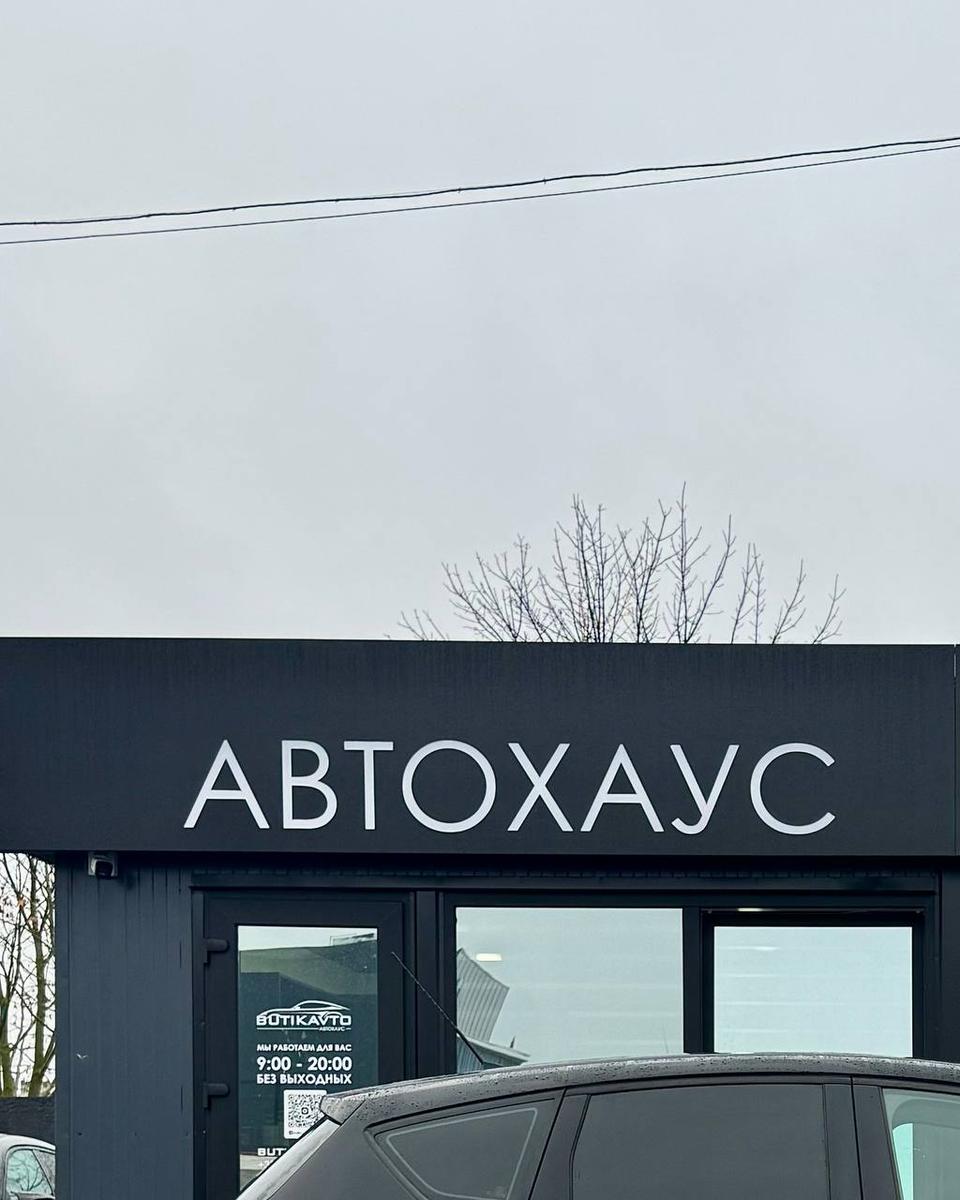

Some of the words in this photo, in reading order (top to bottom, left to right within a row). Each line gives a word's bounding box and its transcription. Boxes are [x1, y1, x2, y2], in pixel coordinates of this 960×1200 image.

[184, 740, 836, 835] АВТОХАУС
[256, 1014, 352, 1026] BUTIKAVTO
[256, 1044, 272, 1052] МЫ
[273, 1044, 315, 1052] РАБОТАЕМ
[316, 1044, 333, 1053] ДЛЯ
[335, 1044, 352, 1052] ВАС
[256, 1057, 291, 1071] 9:00
[307, 1057, 353, 1071] 20:00
[256, 1074, 276, 1085] БЕЗ
[280, 1074, 352, 1086] ВЫХОДНЫХ
